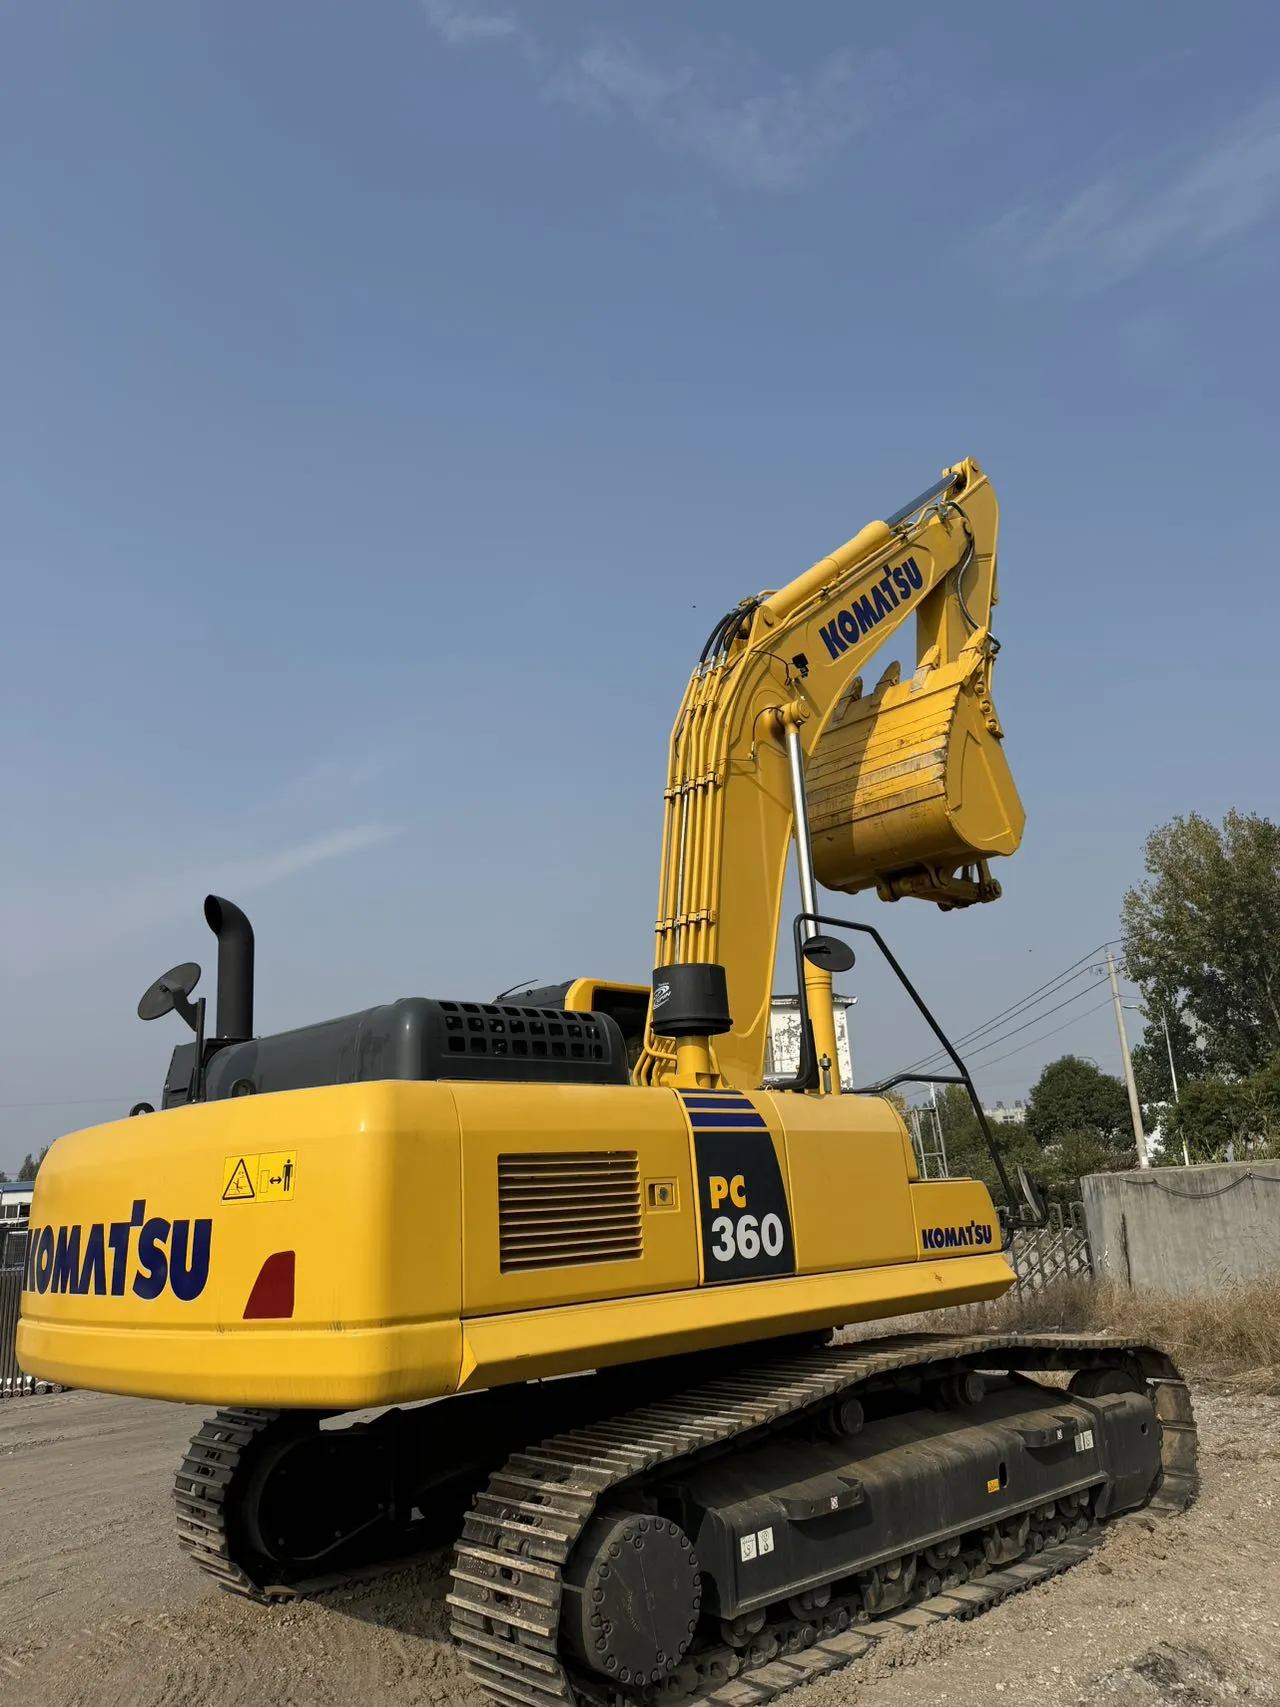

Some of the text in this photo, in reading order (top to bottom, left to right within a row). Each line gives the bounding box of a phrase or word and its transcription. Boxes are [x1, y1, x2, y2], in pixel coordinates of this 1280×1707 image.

[819, 557, 923, 660] KOMATSU
[709, 1174, 747, 1209] PC
[23, 1199, 213, 1301] KOMATSU
[711, 1212, 784, 1262] 360
[921, 1220, 993, 1250] KOMATSU
